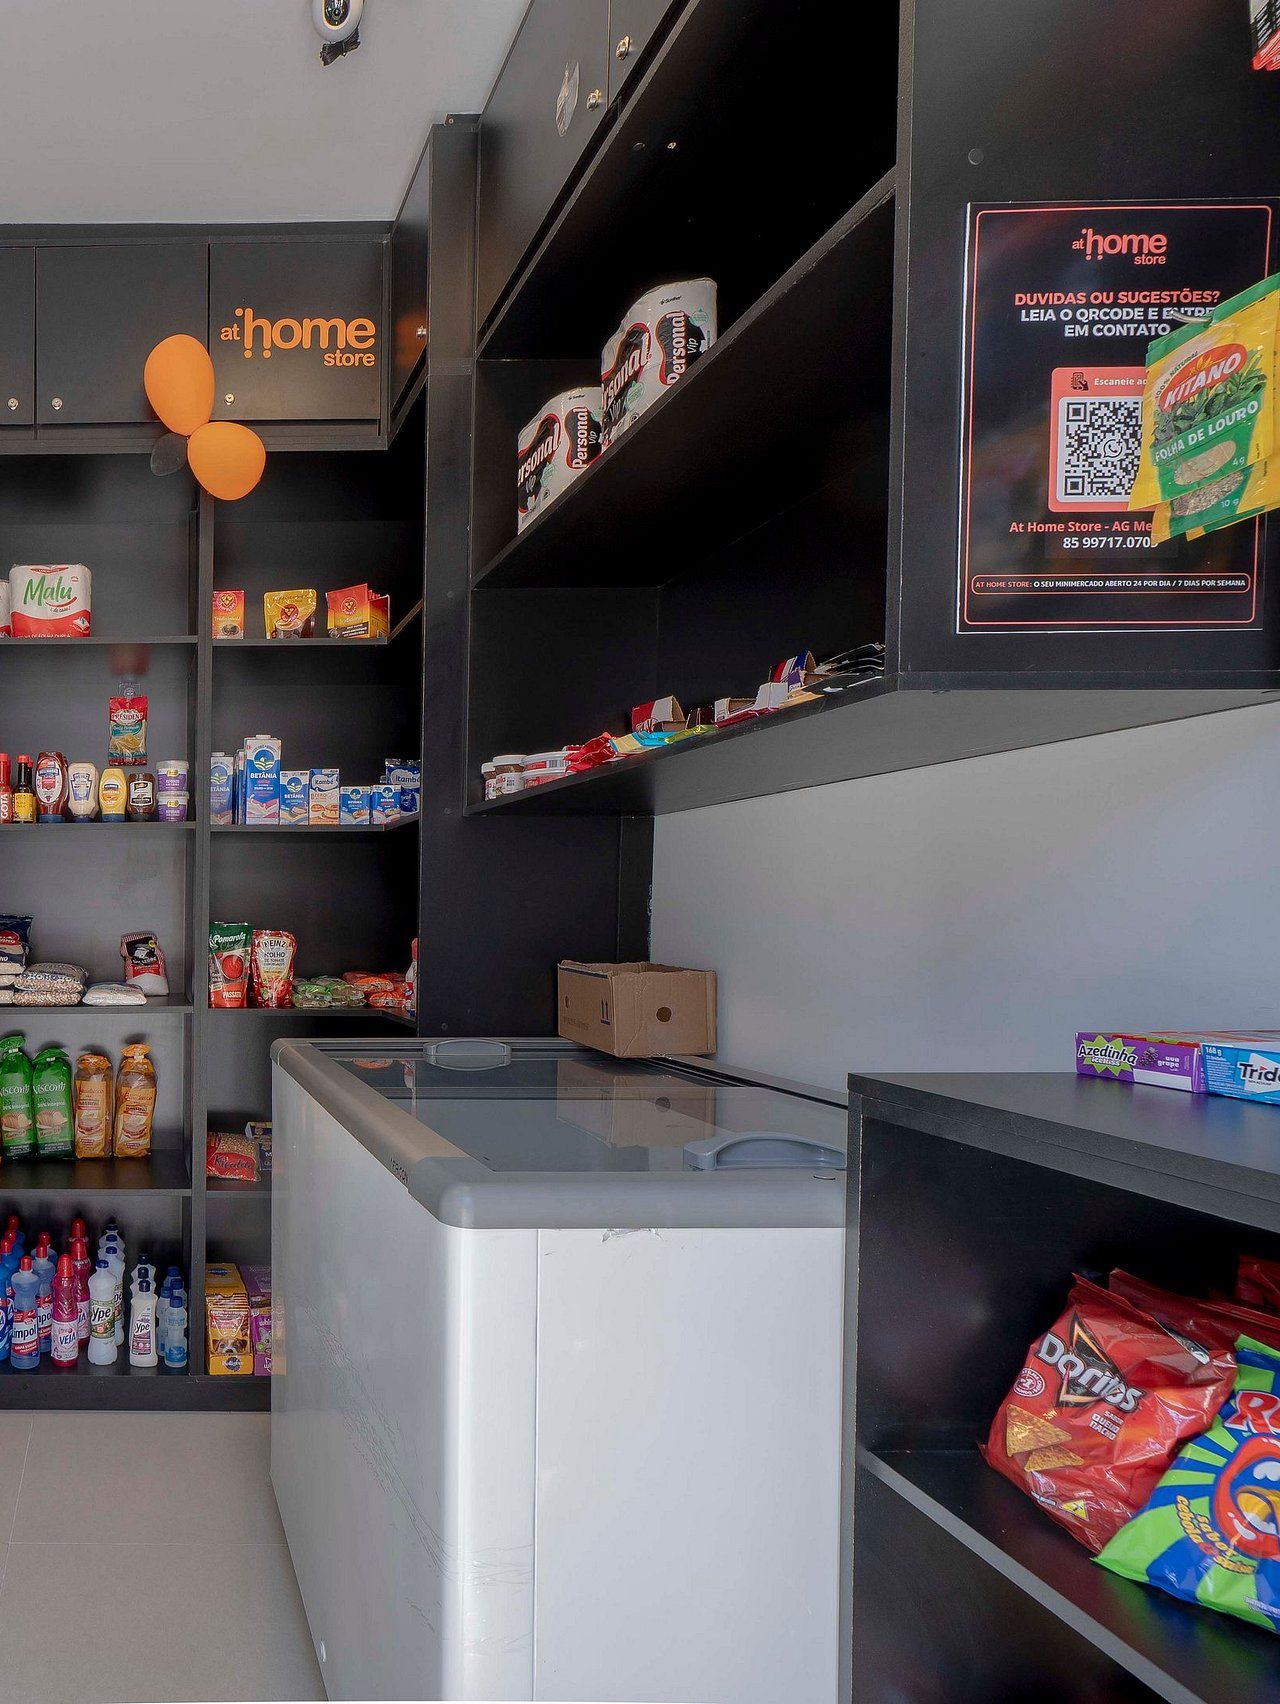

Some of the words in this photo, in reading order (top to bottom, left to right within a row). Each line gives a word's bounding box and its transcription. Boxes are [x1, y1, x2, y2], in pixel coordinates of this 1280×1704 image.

[1072, 239, 1084, 249] at
[1085, 228, 1167, 255] home
[1134, 254, 1166, 265] store
[1014, 292, 1087, 306] DUVIDAS
[1090, 291, 1114, 305] OU
[1117, 287, 1221, 304] SUGESTÕES?
[1021, 309, 1056, 322] LEIA
[1059, 308, 1073, 321] O
[1076, 307, 1145, 322] QRCODE
[1148, 308, 1158, 320] E
[220, 323, 240, 340] at
[244, 307, 376, 350] home
[1064, 325, 1089, 337] EM
[1093, 323, 1170, 336] CONTATO
[666, 310, 686, 385] Personal
[687, 337, 699, 354] Vip
[323, 350, 376, 367] store
[1094, 377, 1135, 387] Escaneie
[1163, 352, 1242, 410] KITANO
[572, 406, 589, 469] Personal
[1154, 441, 1185, 463] FOLHA
[1188, 430, 1206, 447] DE
[1208, 400, 1259, 437] LOURO
[1009, 522, 1025, 533] At
[1027, 522, 1065, 532] Home
[1067, 521, 1102, 532] Store
[1111, 521, 1130, 532] AG
[1133, 521, 1153, 531] Me
[1062, 538, 1080, 549] 85
[22, 575, 73, 607] Malu
[250, 771, 277, 779] BETÂNIA
[213, 932, 247, 943] Pomarola
[1077, 1045, 1138, 1066] Azedinha
[1157, 1060, 1180, 1069] grape
[59, 1332, 76, 1346] VEJA
[1036, 1331, 1145, 1412] Doritos
[1176, 1494, 1204, 1544] cebola
